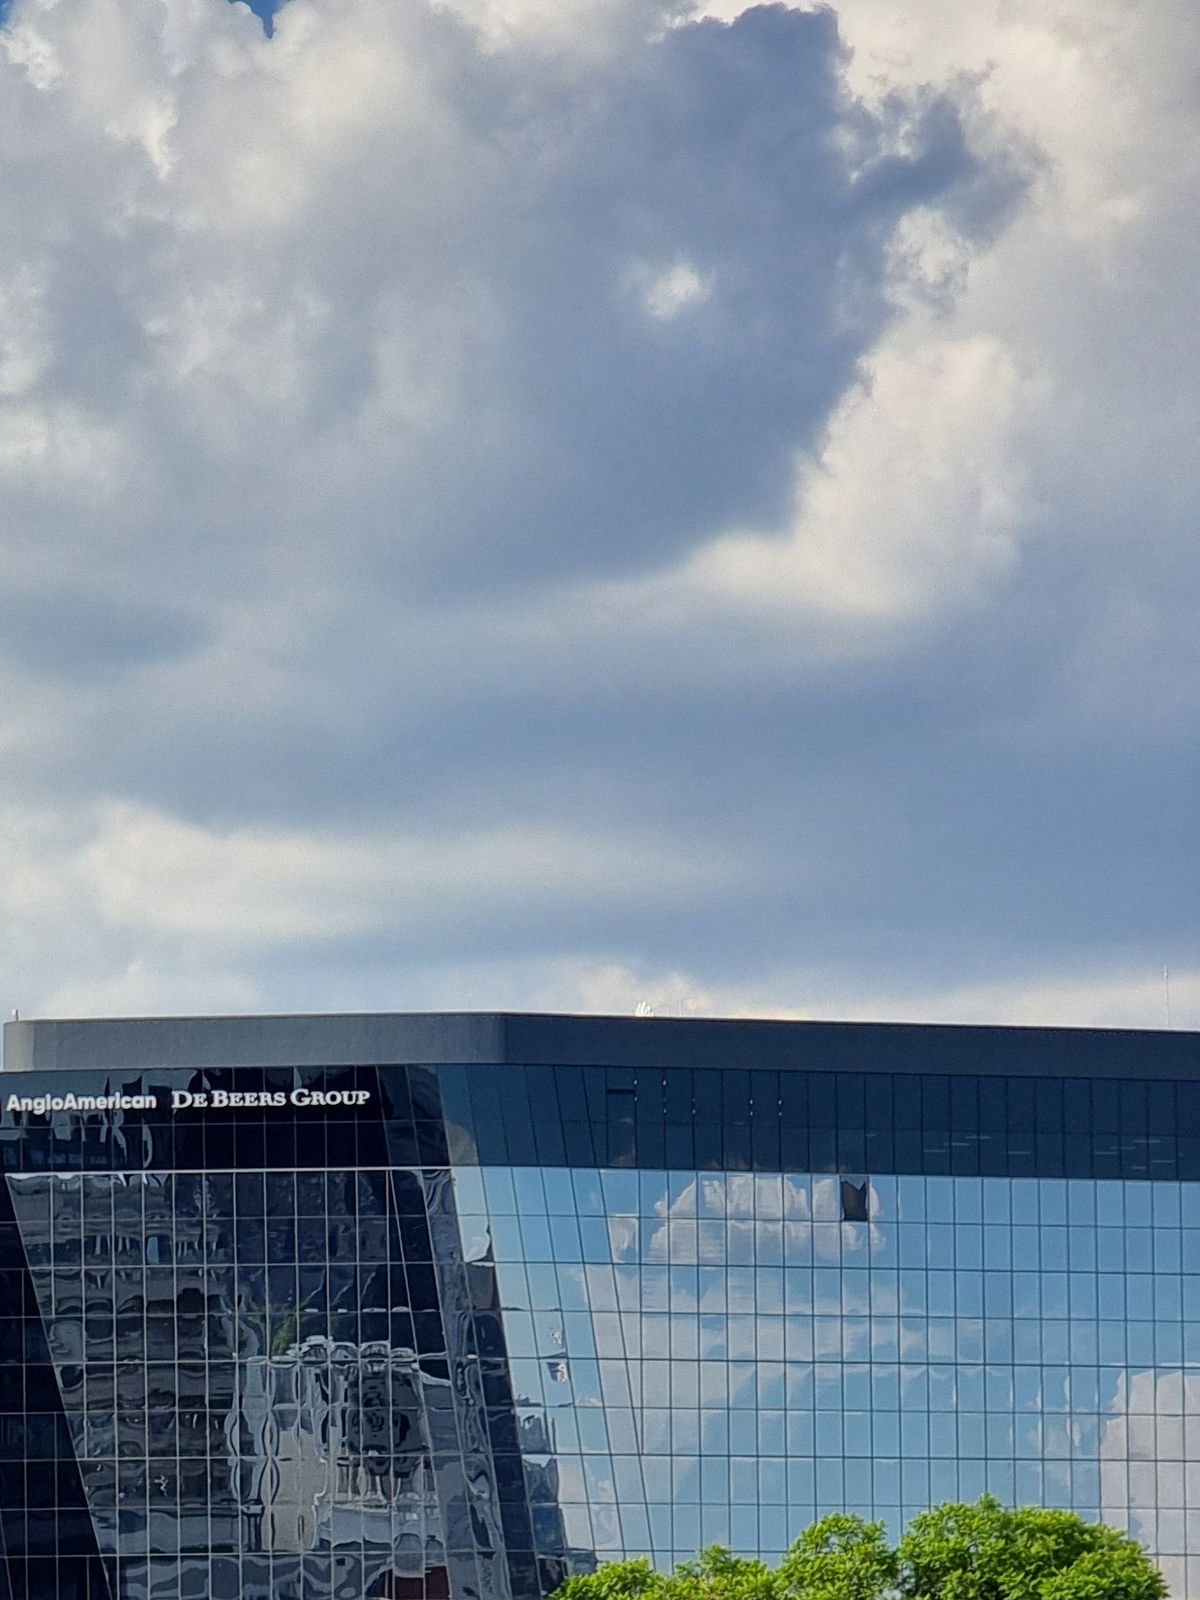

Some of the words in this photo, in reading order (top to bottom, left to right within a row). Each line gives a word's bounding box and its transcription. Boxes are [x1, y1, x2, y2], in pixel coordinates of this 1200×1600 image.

[6, 1092, 157, 1115] AngloAmerican
[210, 1089, 287, 1108] BEERS
[290, 1088, 371, 1107] GROUP
